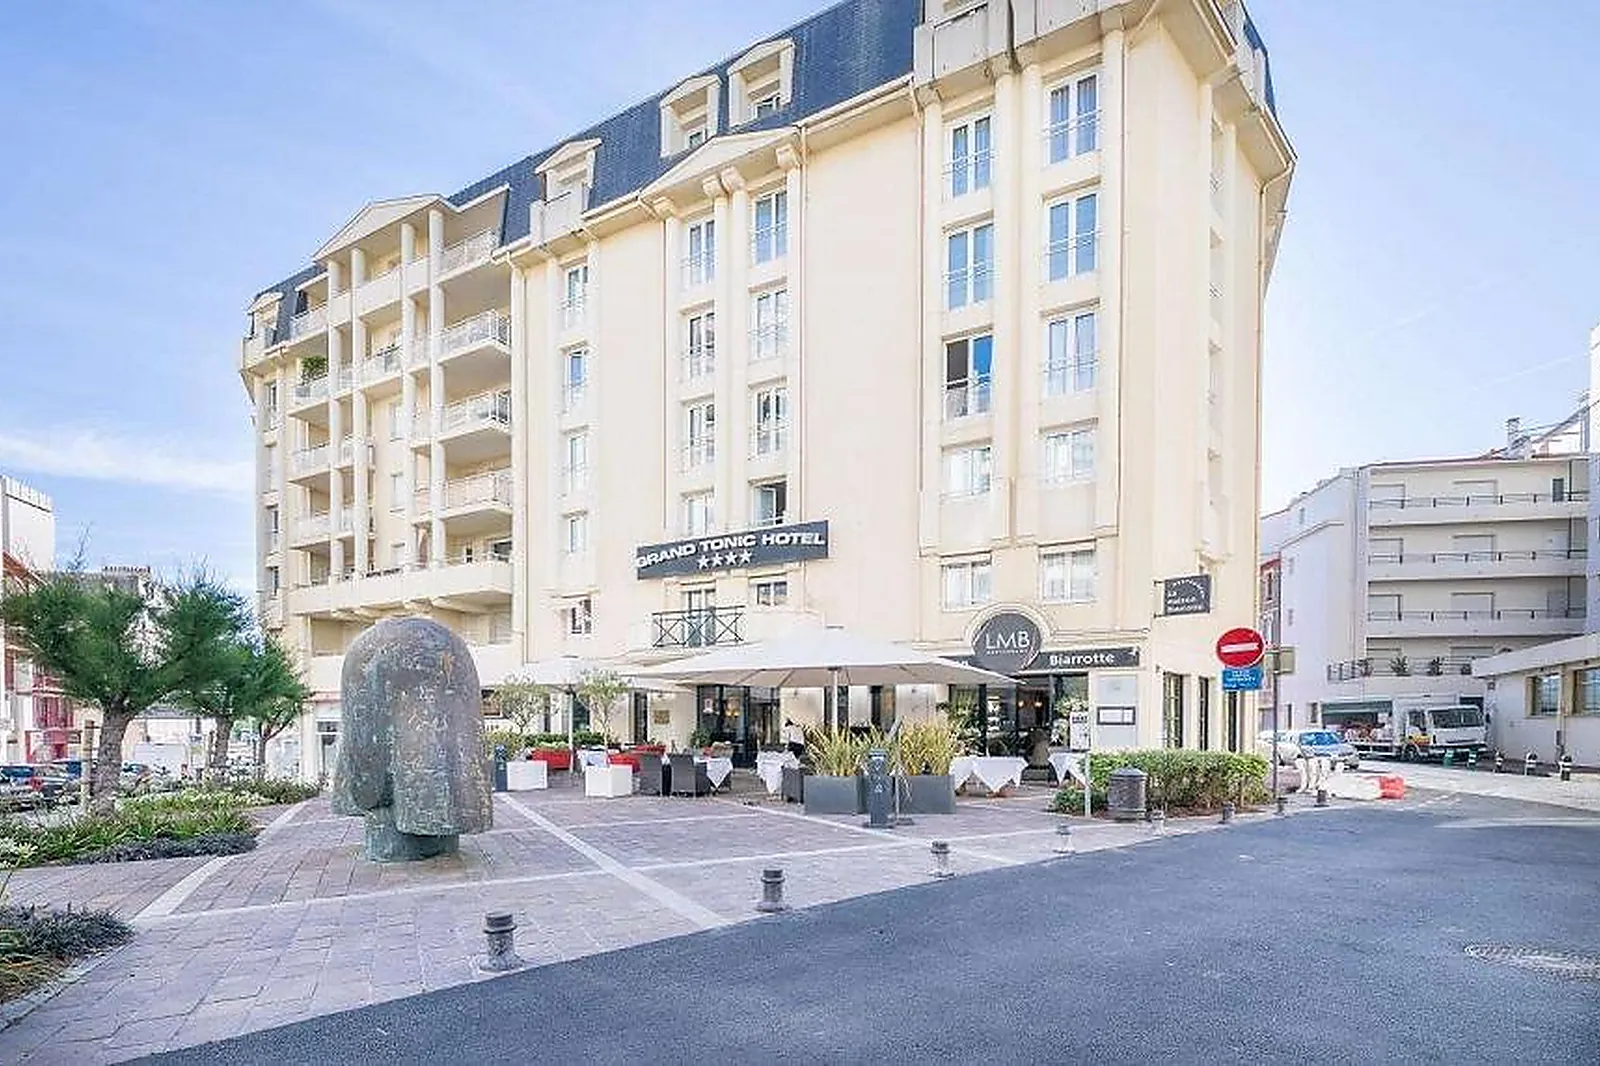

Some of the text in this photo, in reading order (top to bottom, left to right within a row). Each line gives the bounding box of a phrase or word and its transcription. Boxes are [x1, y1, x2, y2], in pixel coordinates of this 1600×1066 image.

[636, 532, 826, 568] GRAND TONIC HOTEL
[986, 630, 1031, 648] LMB
